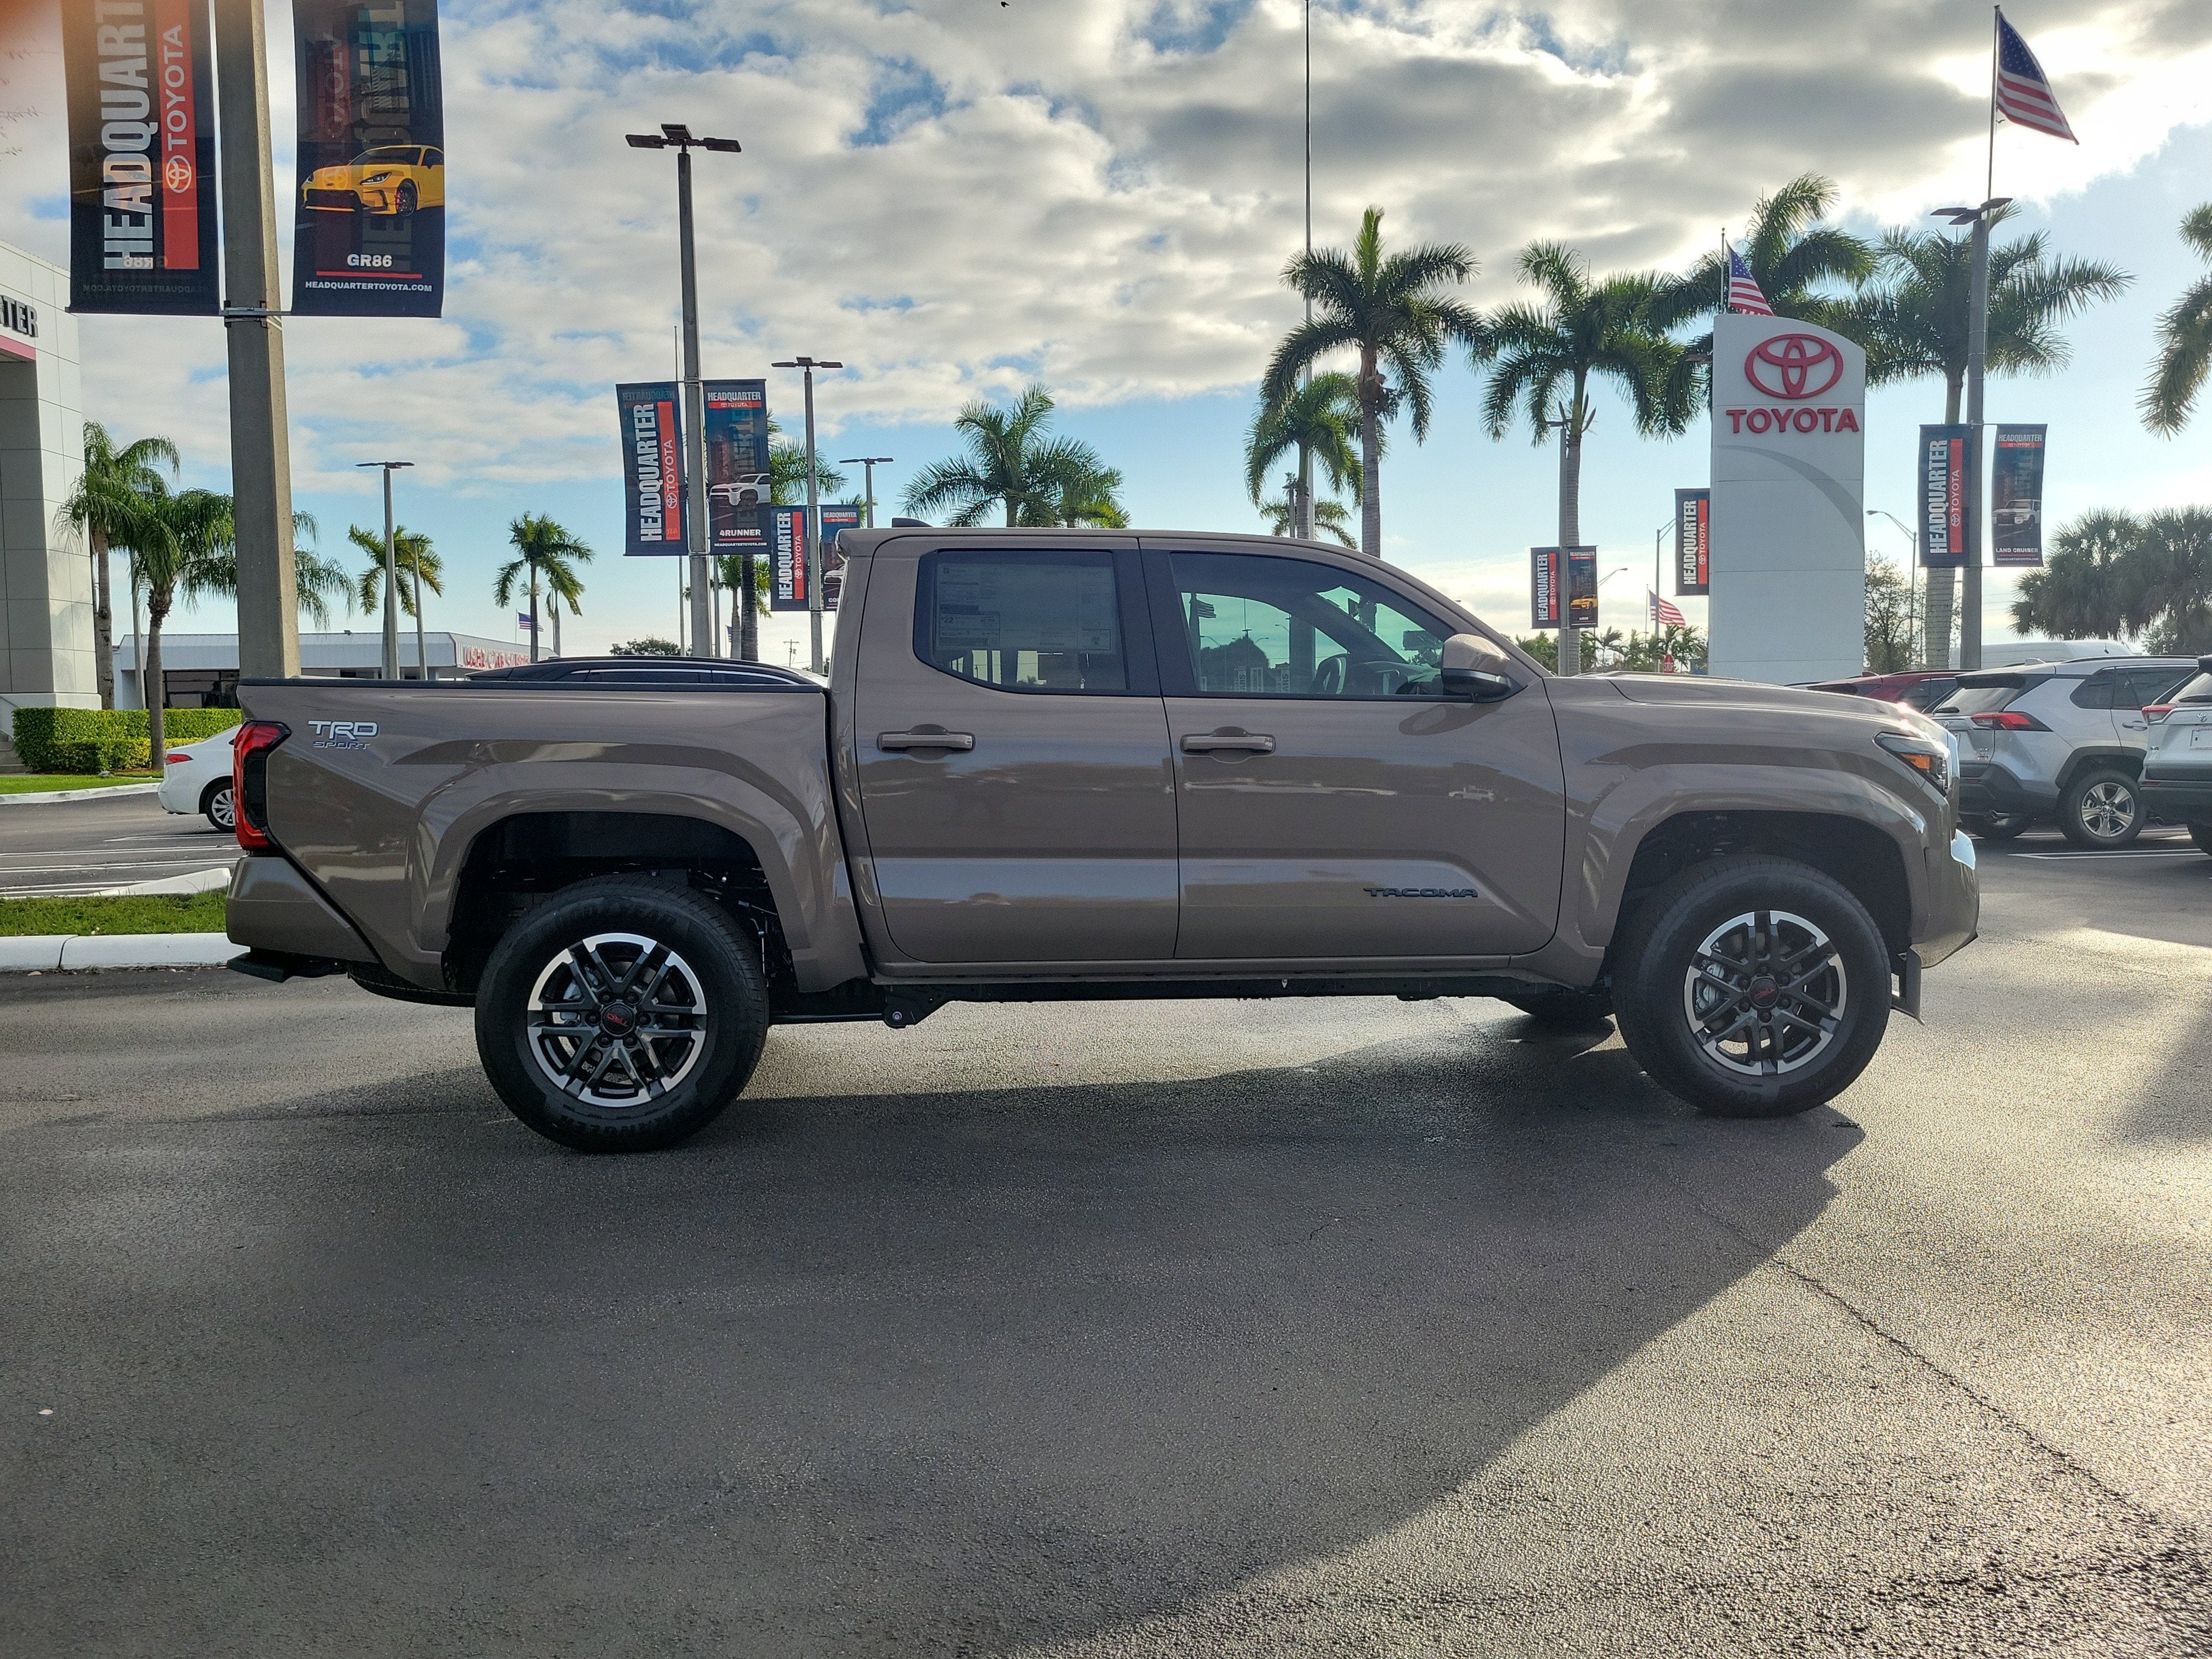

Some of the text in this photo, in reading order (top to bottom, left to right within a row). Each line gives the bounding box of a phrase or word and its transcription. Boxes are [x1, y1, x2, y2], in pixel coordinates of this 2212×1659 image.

[162, 24, 188, 151] TOYOTA
[347, 253, 393, 268] GR86
[305, 281, 433, 292] HEADQUARTERTOYOTA.COM
[708, 391, 761, 402] HEADQUARTER
[1726, 408, 1859, 433] TOYOTA
[1999, 434, 2042, 443] HEADQUARTER
[633, 403, 664, 541] HEADQUARTER
[663, 439, 675, 492] TOYOTA
[1928, 440, 1949, 554] HEADQUARTER
[1951, 470, 1960, 512] TOYOTA
[777, 512, 794, 599] HEADQUARTER
[1683, 500, 1698, 584] HEADQUARTER
[1537, 554, 1549, 620] HEADQUARTER
[308, 720, 378, 740] TRD
[313, 742, 371, 750] SPORT
[1363, 888, 1479, 898] TACOMA
